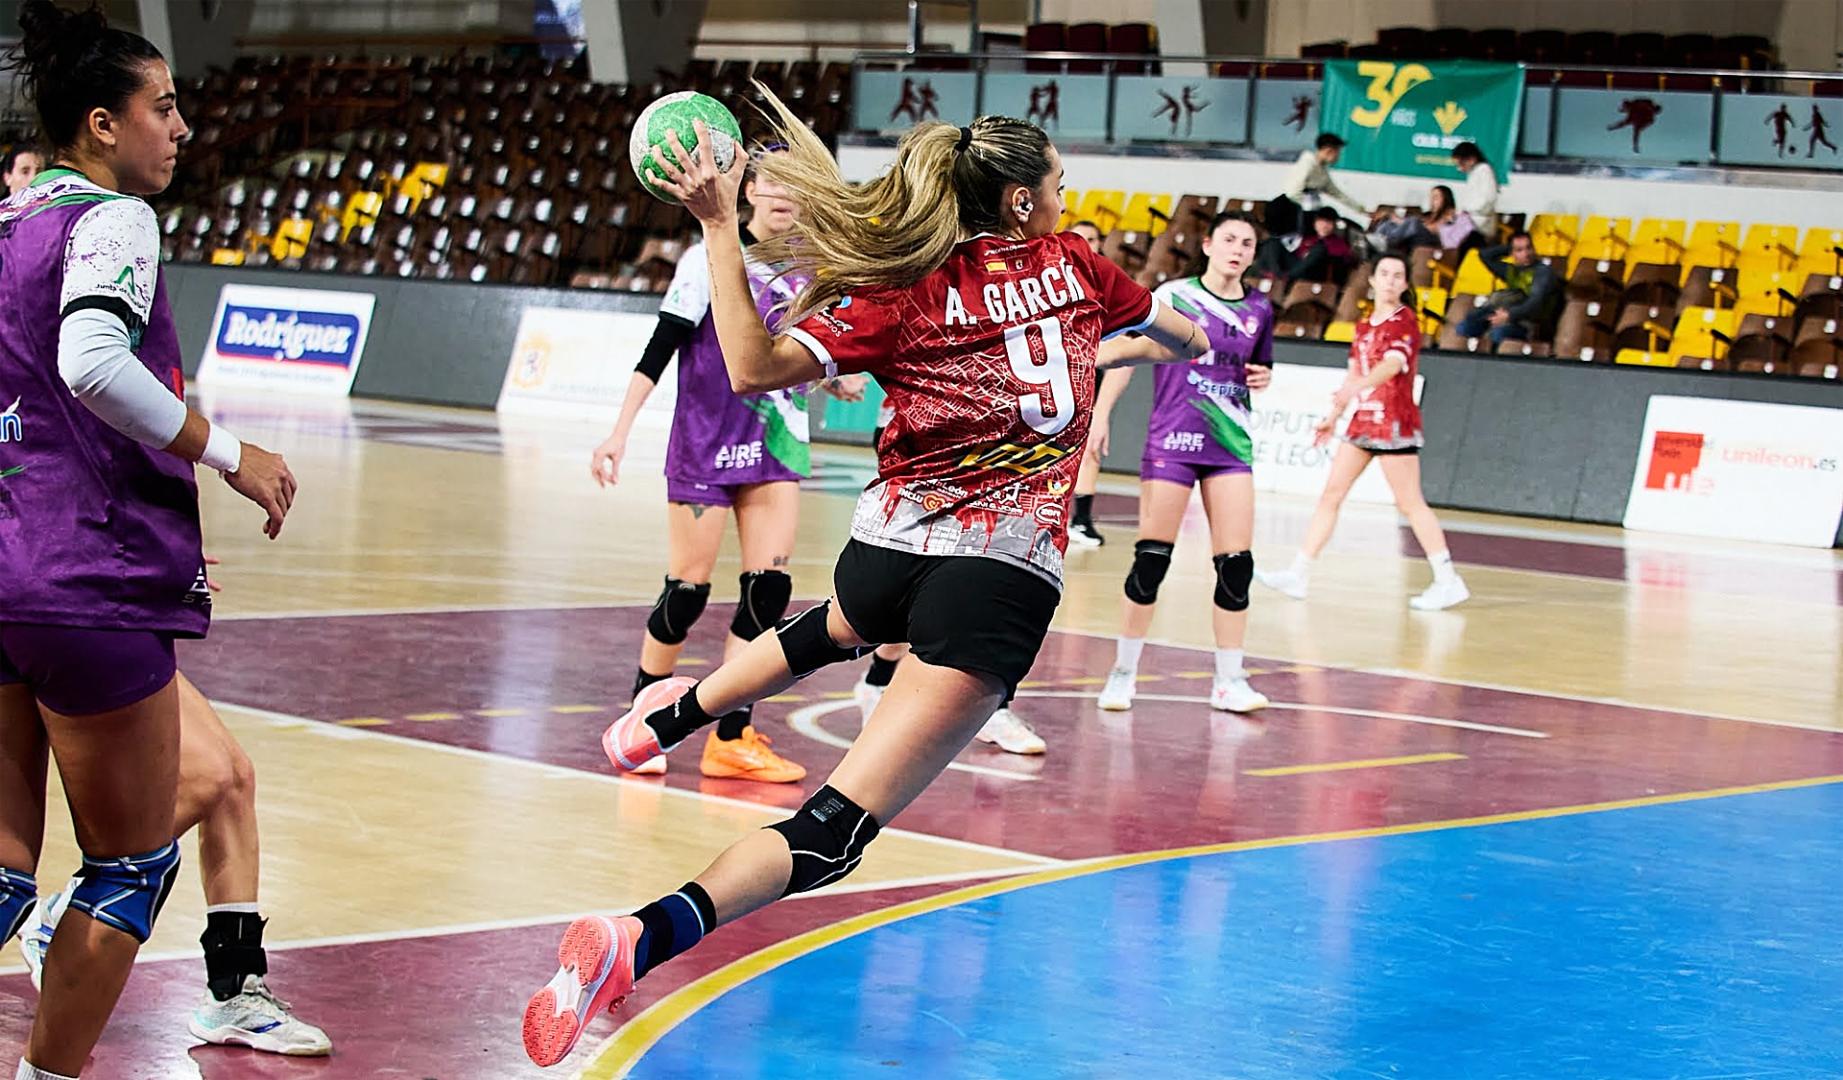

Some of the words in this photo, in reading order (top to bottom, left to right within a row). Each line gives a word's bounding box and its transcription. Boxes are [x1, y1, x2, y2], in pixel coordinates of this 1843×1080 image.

[944, 286, 977, 326] A.
[223, 310, 353, 360] Rodríguez
[1003, 316, 1075, 435] 9
[716, 440, 763, 461] AIRE
[1165, 432, 1205, 447] AIRE
